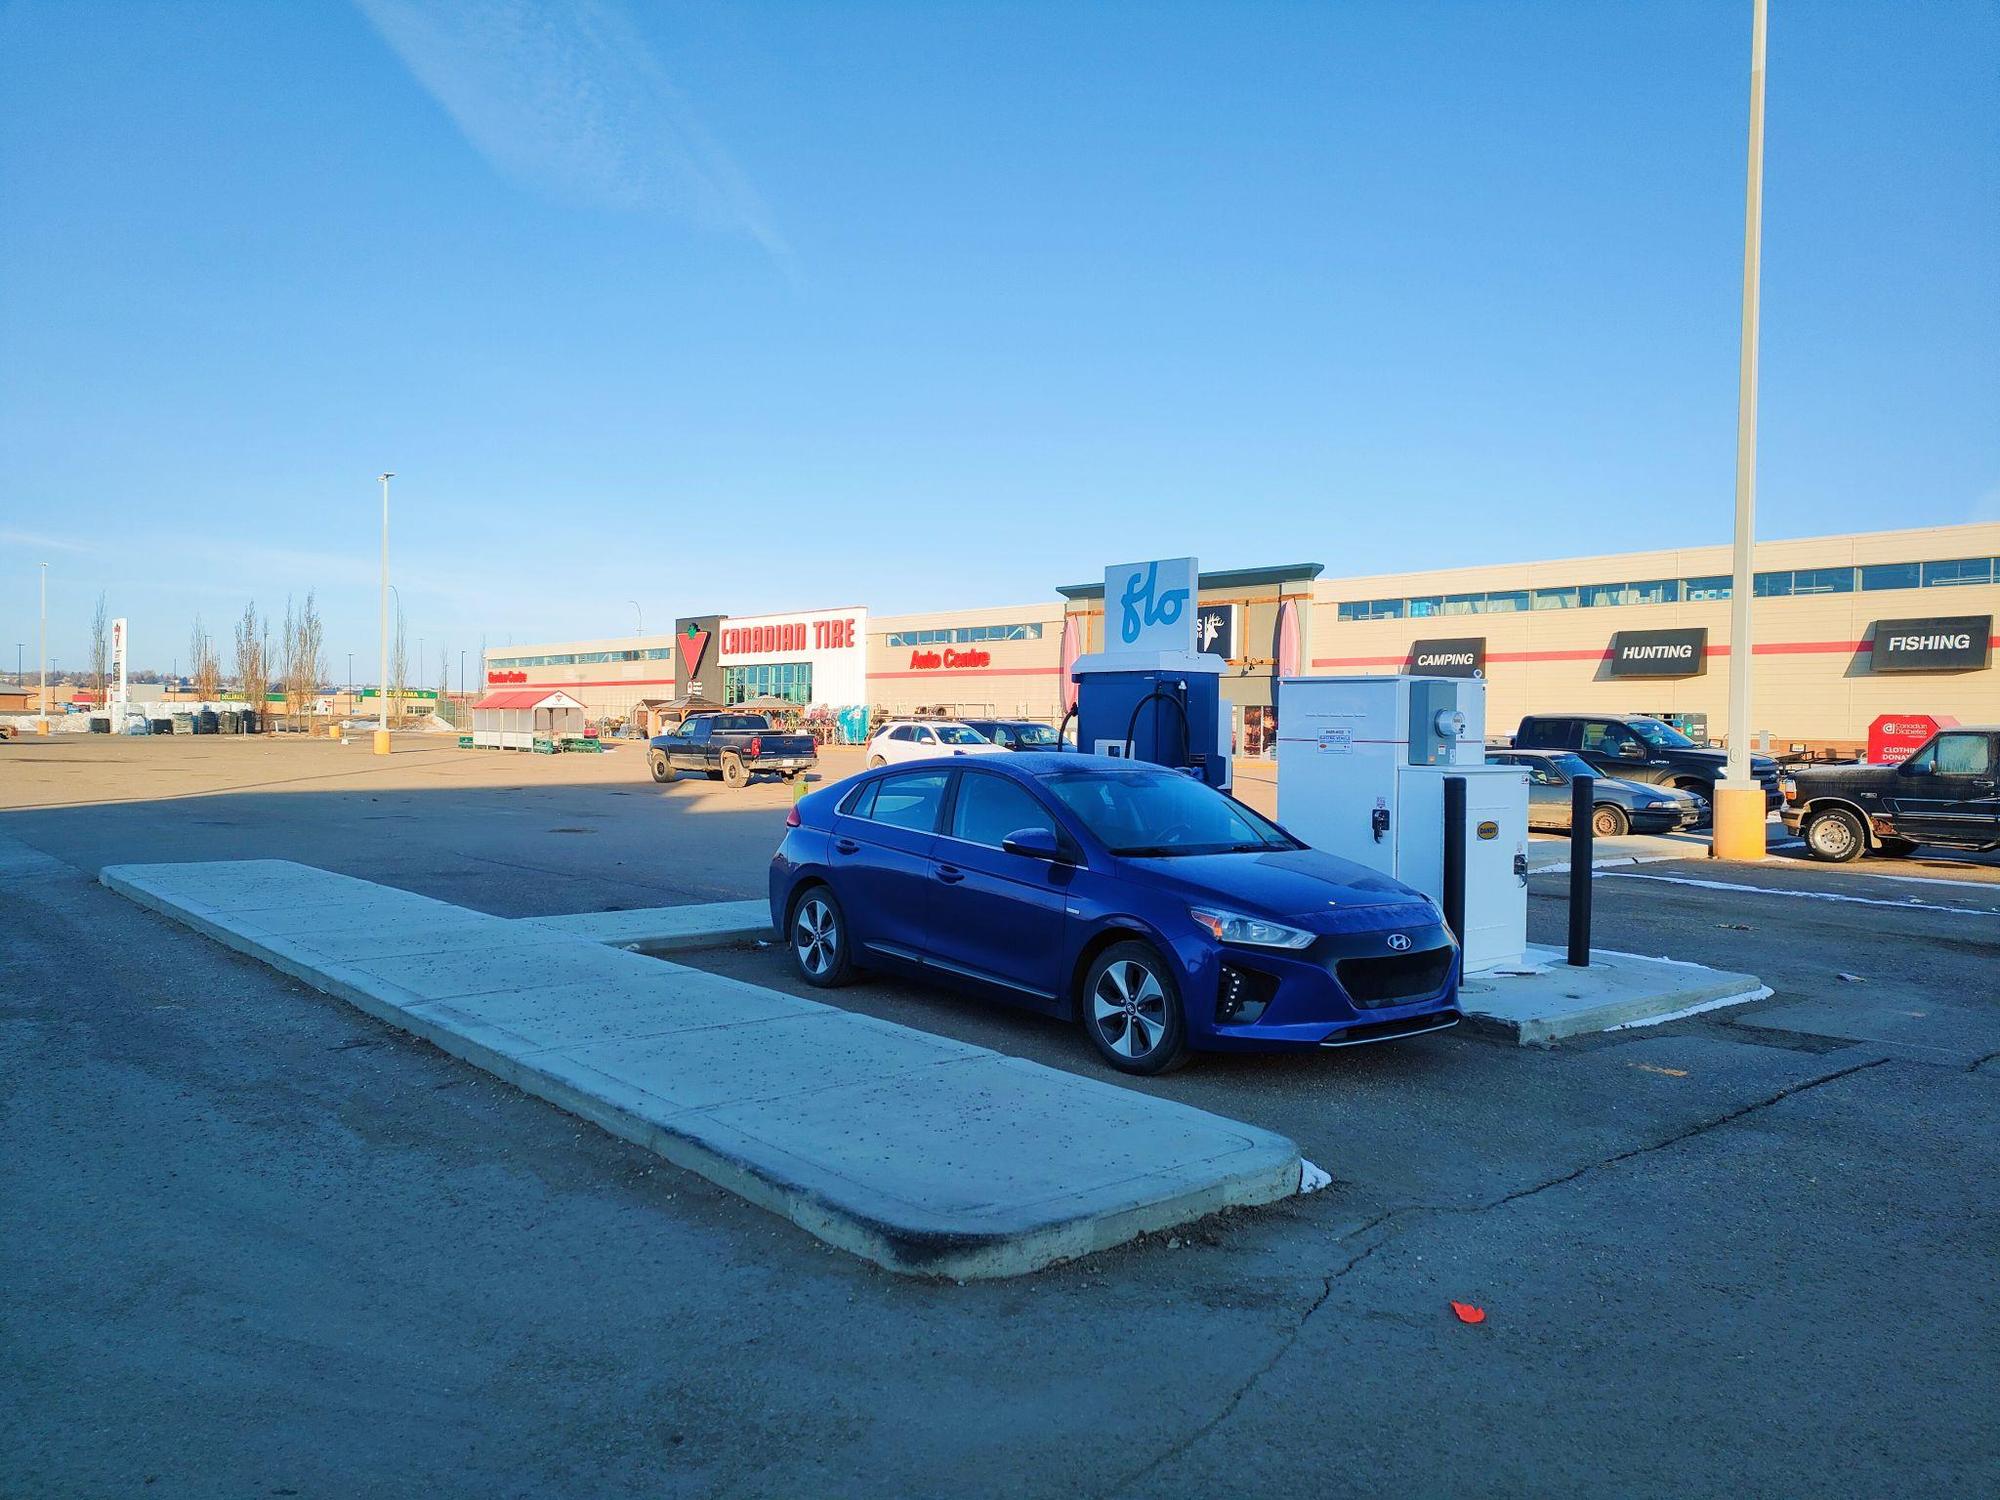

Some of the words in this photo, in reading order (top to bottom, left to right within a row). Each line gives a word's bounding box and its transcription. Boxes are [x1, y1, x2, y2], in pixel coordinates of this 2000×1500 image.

[1121, 562, 1190, 644] flo
[721, 623, 807, 655] CANADIAN
[813, 618, 856, 650] TIRE
[1889, 634, 1970, 651] FISHING
[910, 650, 942, 669] Auto
[943, 648, 991, 668] Centre
[1417, 653, 1474, 666] CAMPING
[1622, 645, 1692, 659] HUNTING
